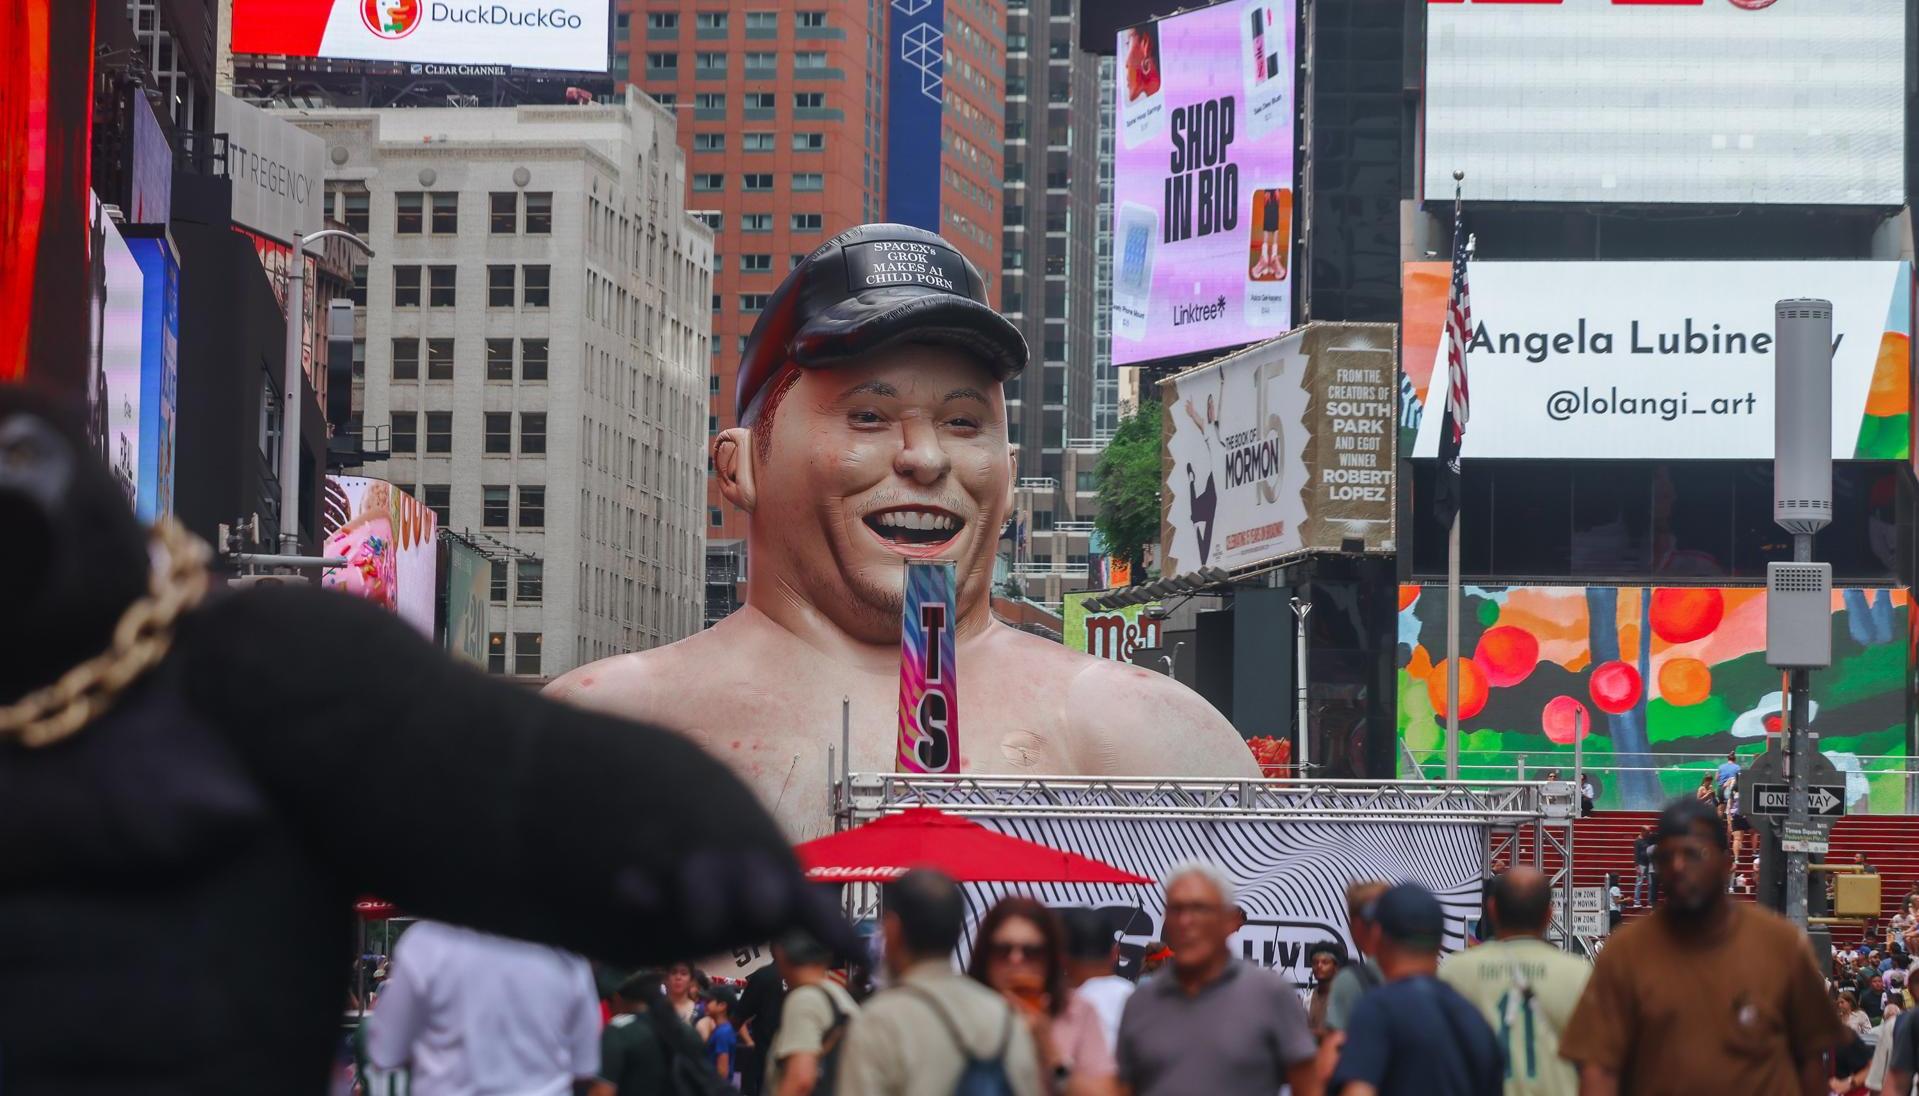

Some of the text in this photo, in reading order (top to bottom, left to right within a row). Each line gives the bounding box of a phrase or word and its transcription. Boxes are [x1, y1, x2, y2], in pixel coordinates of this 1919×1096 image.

[432, 3, 582, 29] DuckDuckGo
[425, 64, 506, 76] CLEAR CHANNEL
[1171, 95, 1235, 174] SHOP
[251, 152, 313, 208] REGENCY
[1164, 162, 1238, 244] IN BIO
[874, 242, 936, 255] SPACEX's
[887, 252, 928, 264] GROK
[873, 263, 944, 277] MAKES AI
[866, 273, 953, 290] CHILD PORN
[1174, 303, 1217, 326] Linktree
[1466, 318, 1844, 363] Angela Lubiney
[1337, 369, 1381, 383] FROM THE
[1328, 385, 1390, 400] CREATORS OF
[1326, 402, 1391, 417] SOUTH
[1547, 387, 1756, 421] @lolangi_art
[1333, 419, 1384, 434] PARK
[1226, 428, 1257, 450] THE BOOK OF
[1335, 436, 1380, 450] AND EGOT
[1225, 437, 1279, 490] MORMON
[1339, 453, 1376, 467] WINNER
[1323, 469, 1392, 484] ROBERT
[1330, 486, 1386, 501] LOPEZ
[805, 866, 910, 877] SQUARE
